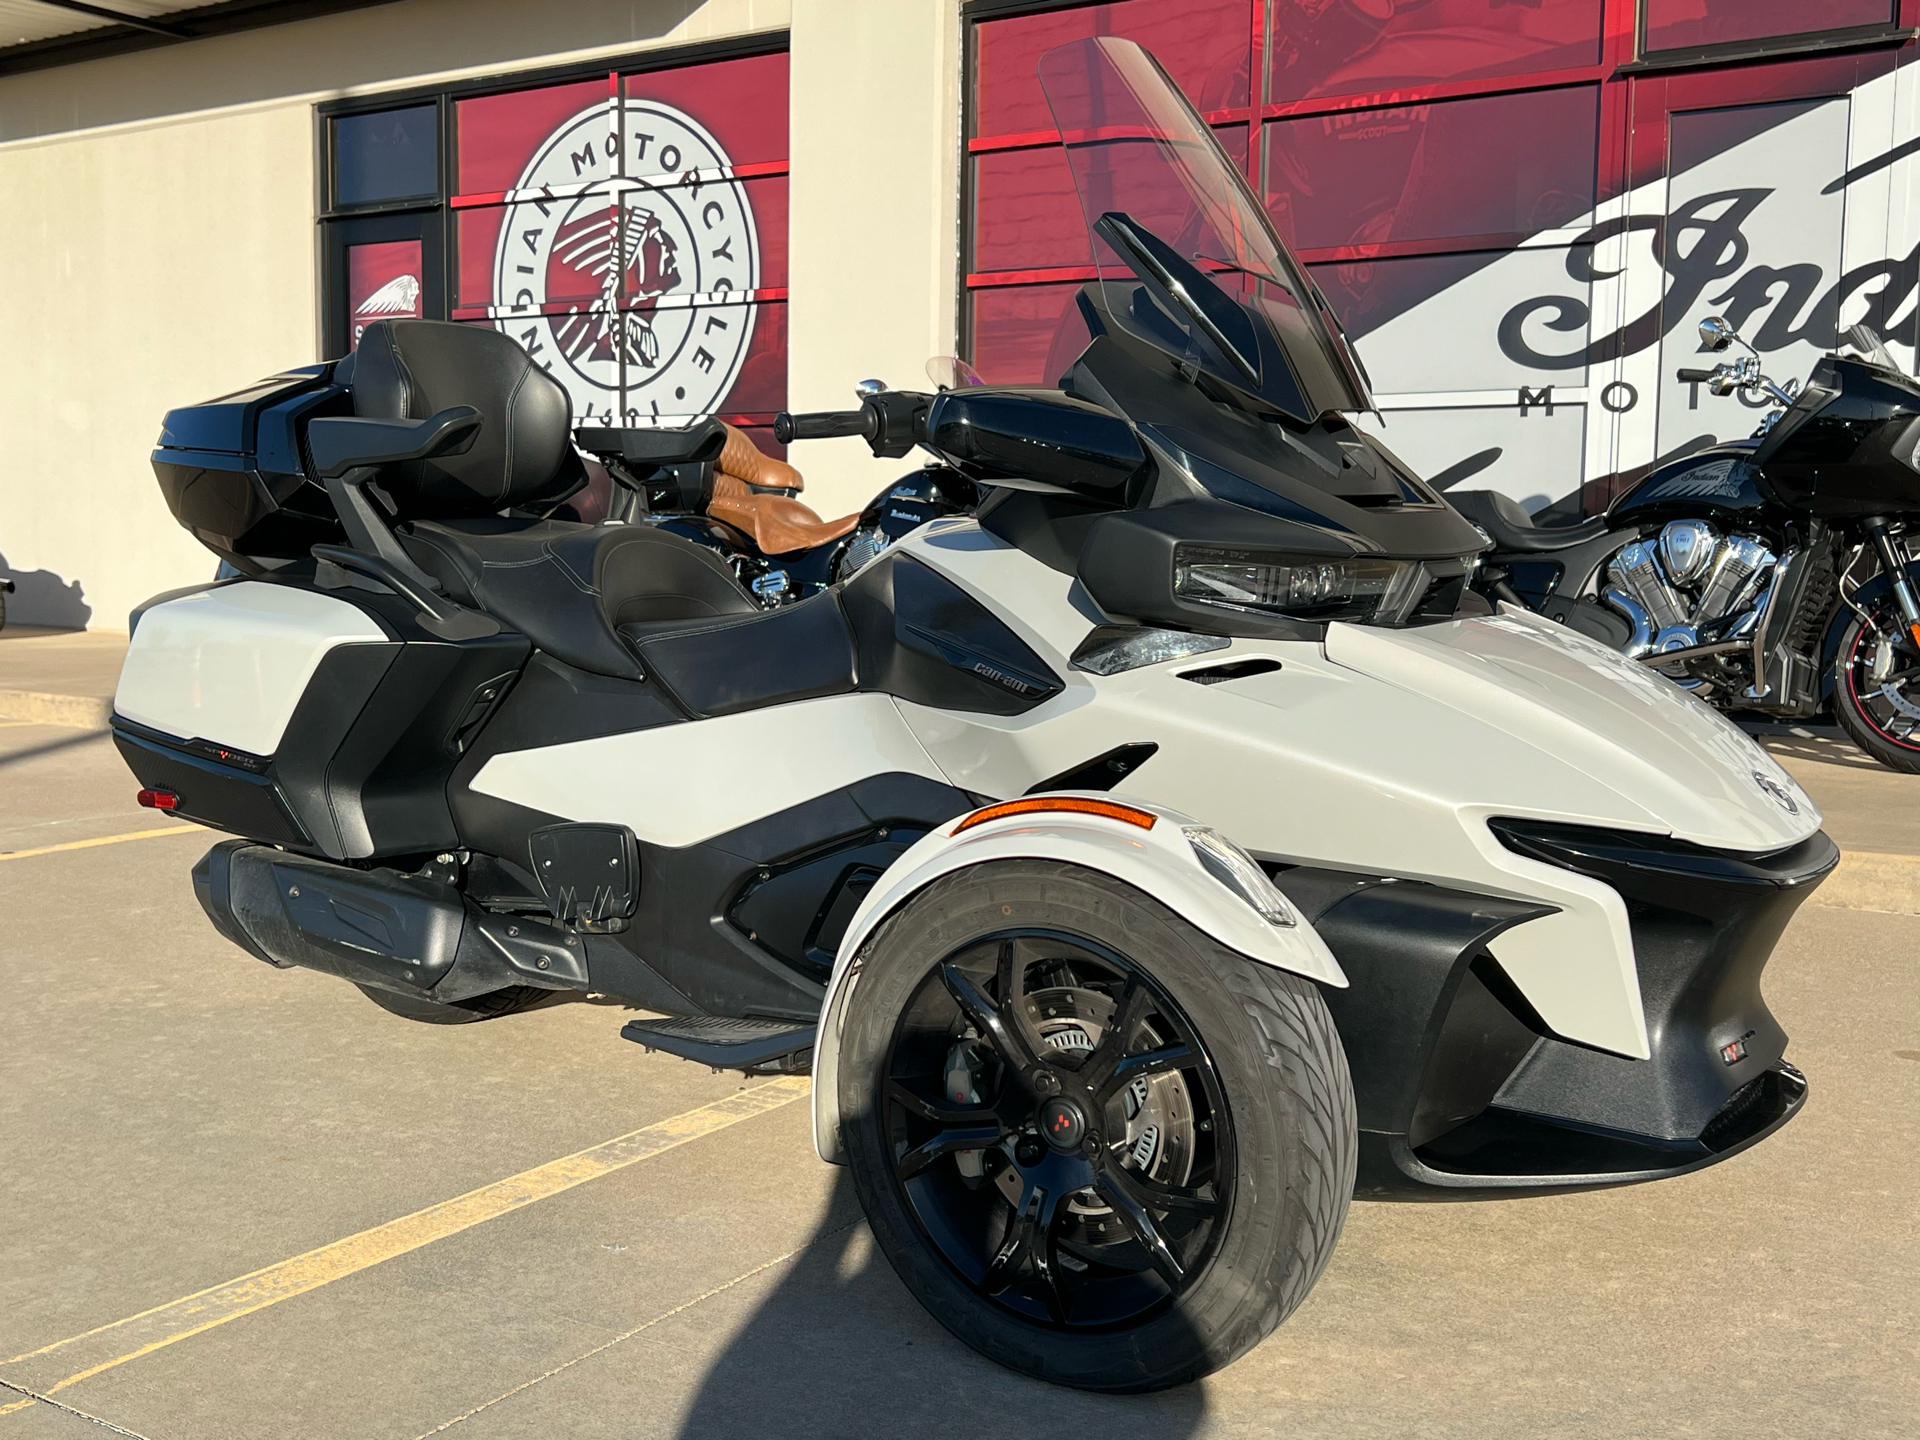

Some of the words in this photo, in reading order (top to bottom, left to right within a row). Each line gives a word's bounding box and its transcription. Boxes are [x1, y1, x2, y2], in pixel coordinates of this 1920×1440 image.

[1322, 91, 1432, 136] INDIAN
[1359, 126, 1388, 139] SCOUT
[570, 130, 735, 375] MOTORCYCLE
[1681, 471, 1720, 482] Indian
[973, 662, 1029, 693] can-am
[204, 746, 254, 764] SPYDER
